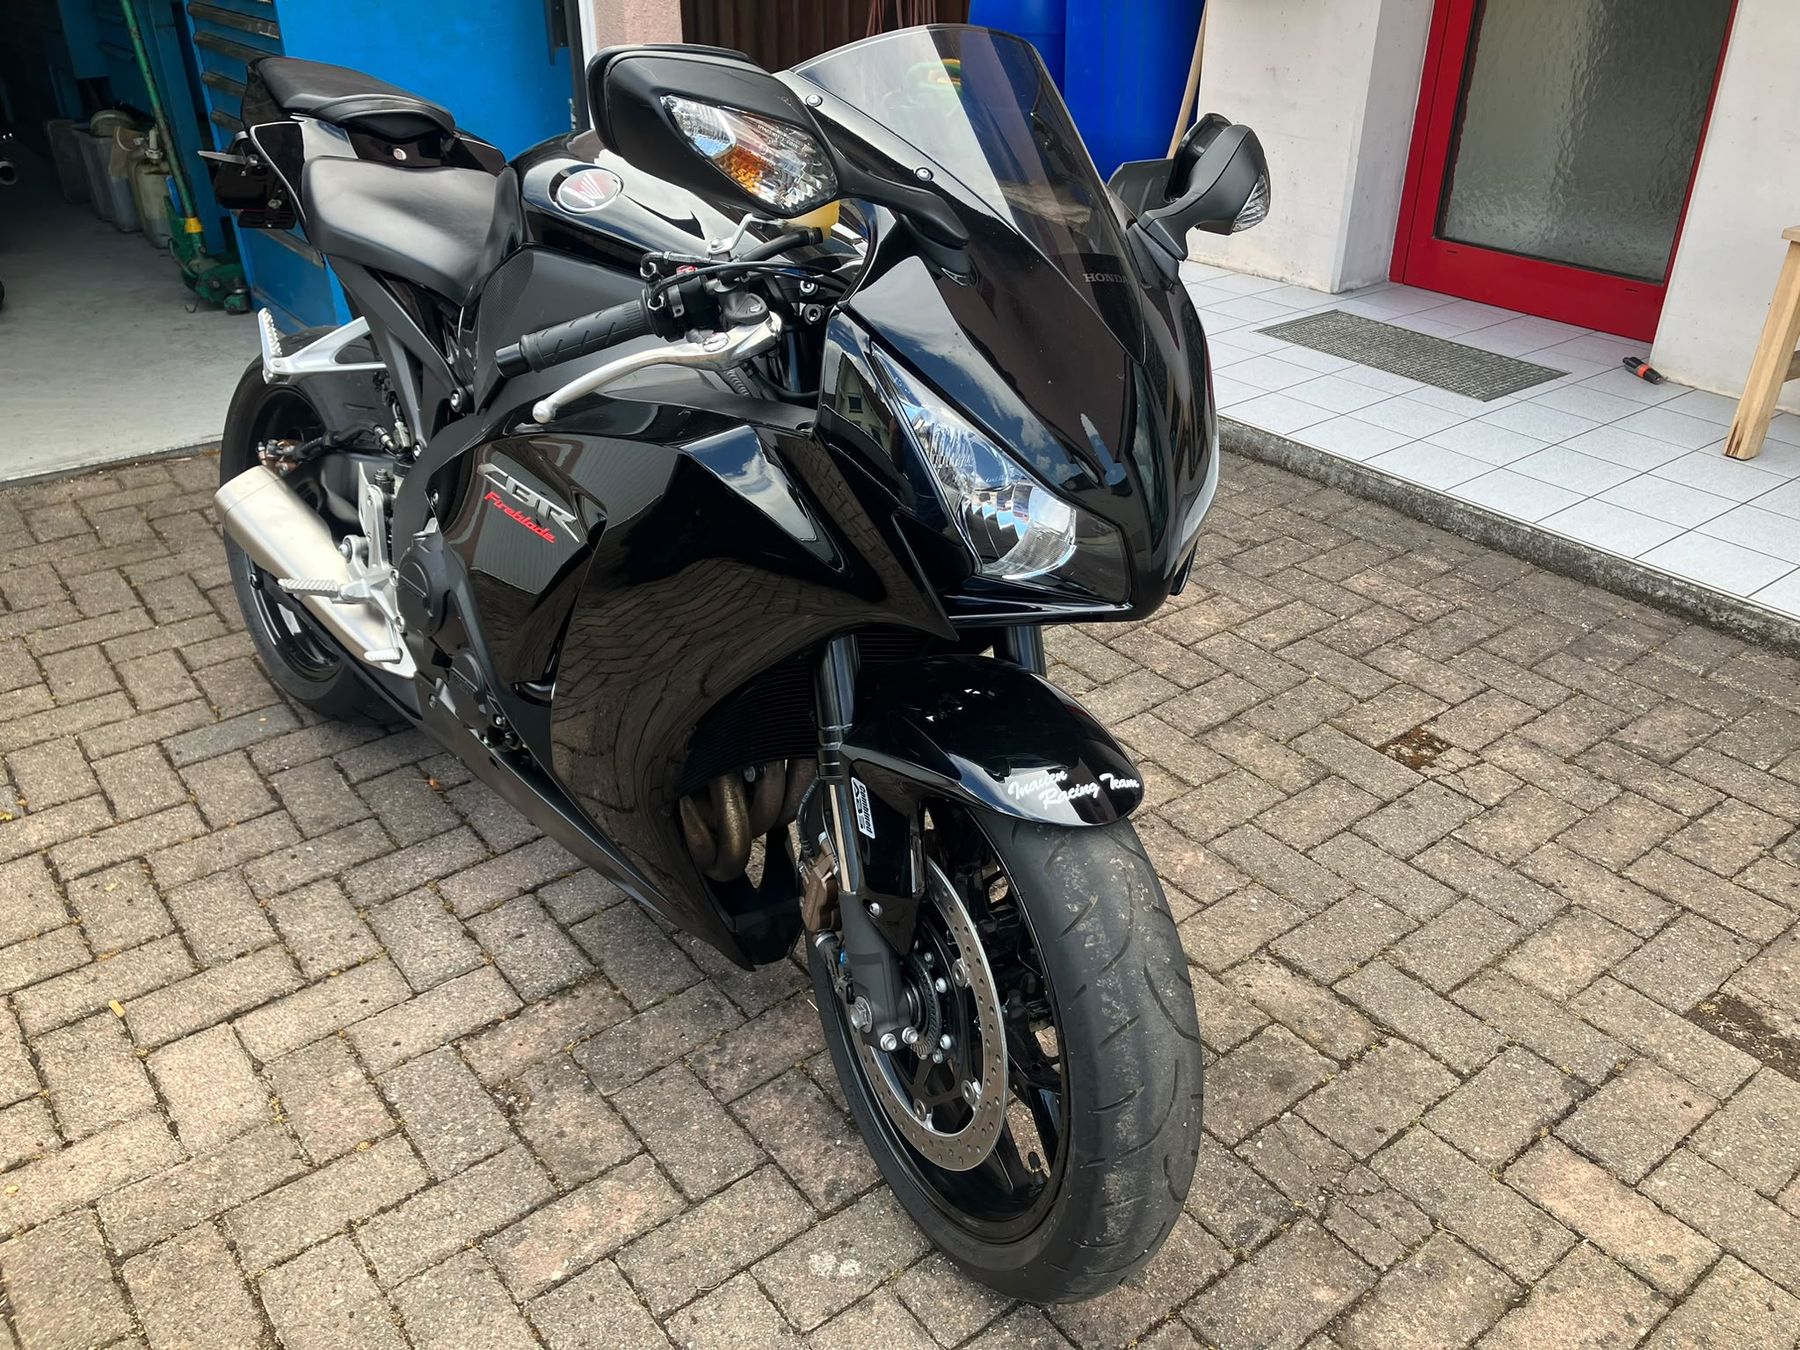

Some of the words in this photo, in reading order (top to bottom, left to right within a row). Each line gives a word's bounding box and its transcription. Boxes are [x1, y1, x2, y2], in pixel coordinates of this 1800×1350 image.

[1083, 273, 1127, 283] HONDA
[477, 463, 580, 543] CBR
[484, 491, 557, 544] Fireblade
[1038, 781, 1100, 810] Racing
[1099, 773, 1140, 790] Team
